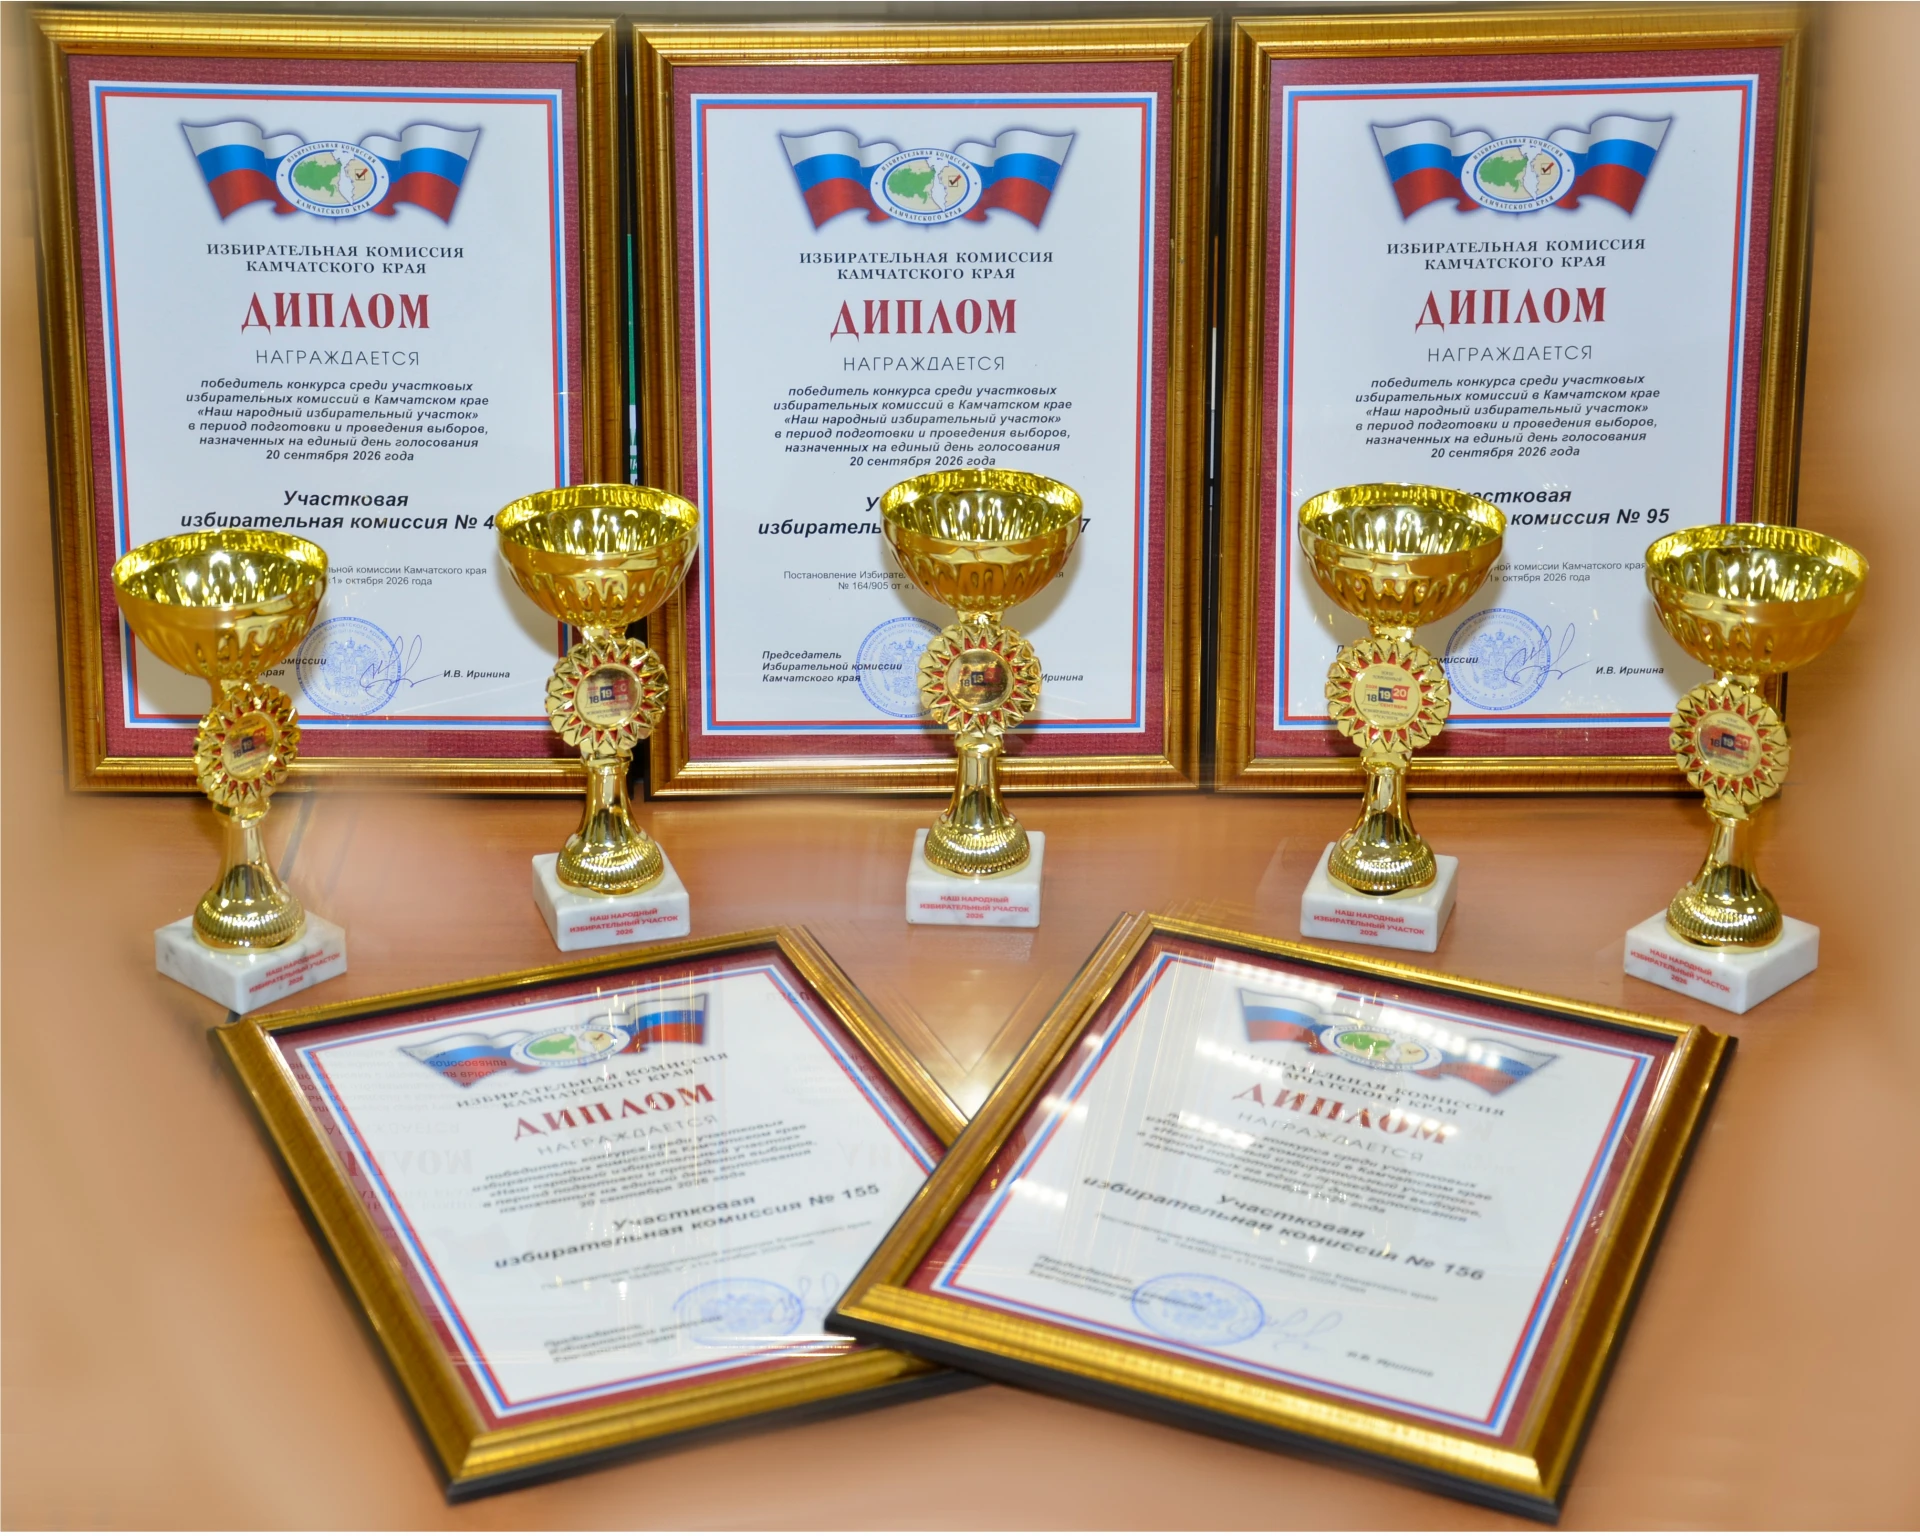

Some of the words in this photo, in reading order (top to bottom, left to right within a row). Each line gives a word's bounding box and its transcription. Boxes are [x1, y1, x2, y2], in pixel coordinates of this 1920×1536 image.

[341, 143, 377, 164] КОМИССИЯ
[295, 198, 350, 215] КАМЧАТСКОГО
[352, 200, 371, 213] КРАЯ
[206, 243, 358, 257] ИЗБИРАТЕЛЬНАЯ
[365, 245, 464, 259] КОМИССИЯ
[1386, 240, 1538, 255] ИЗБИРАТЕЛЬНАЯ
[1545, 238, 1646, 252] КОМИССИЯ
[799, 251, 948, 264] ИЗБИРАТЕЛЬНАЯ
[955, 251, 1054, 264] КОМИССИЯ
[1424, 256, 1554, 271] КАМЧАТСКОГО
[1561, 255, 1606, 268] КРАЯ
[246, 260, 375, 274] КАМЧАТСКОГО
[382, 262, 427, 275] КРАЯ
[837, 268, 965, 280] КАМЧАТСКОГО
[971, 267, 1016, 280] КРАЯ
[240, 291, 430, 335] ДИПЛОМ
[1414, 286, 1607, 333] ДИПЛОМ
[829, 298, 1017, 342] ДИПЛОМ
[255, 349, 420, 367] НАГРАЖДАЕТСЯ
[1427, 344, 1593, 363] НАГРАЖДАЕТСЯ
[843, 355, 1005, 372] НАГРАЖДАЕТСЯ
[200, 377, 284, 390] победитель
[286, 380, 347, 393] конкурса
[348, 379, 389, 393] среди
[390, 382, 474, 394] участковых
[787, 384, 870, 397] победитель
[872, 387, 932, 399] конкурса
[933, 384, 973, 399] среди
[975, 386, 1058, 399] участковых
[185, 391, 294, 405] избирательных
[295, 393, 360, 405] комиссий
[362, 395, 371, 405] в
[373, 393, 457, 406] Камчатском
[459, 396, 490, 409] крае
[197, 405, 234, 418] «Наш
[235, 405, 303, 420] народный
[305, 406, 414, 421] избирательный
[415, 410, 479, 422] участок»
[1365, 405, 1402, 417] «Наш
[1403, 404, 1471, 419] народный
[1473, 402, 1583, 418] избирательный
[1584, 403, 1649, 417] участок»
[187, 422, 196, 431] в
[199, 419, 248, 434] период
[249, 420, 332, 433] подготовки
[334, 423, 343, 433] и
[345, 421, 424, 436] проведения
[426, 422, 489, 437] выборов,
[783, 413, 820, 425] «Наш
[821, 412, 888, 427] народный
[890, 412, 997, 427] избирательный
[999, 414, 1062, 427] участок»
[198, 436, 286, 446] назначенных
[287, 437, 304, 447] на
[306, 434, 358, 447] единый
[360, 435, 392, 448] день
[394, 438, 480, 448] голосования
[265, 448, 281, 461] 20
[283, 449, 349, 463] сентября
[352, 449, 382, 462] 2026
[383, 449, 415, 462] года
[1430, 447, 1446, 459] 20
[1447, 446, 1515, 460] сентября
[1517, 445, 1548, 458] 2026
[1549, 445, 1581, 457] года
[849, 455, 865, 467] 20
[866, 455, 932, 469] сентября
[934, 455, 964, 467] 2026
[965, 454, 997, 470] года
[283, 489, 409, 508] Участковая
[180, 510, 345, 530] избирательная
[349, 516, 449, 530] комиссия
[453, 513, 479, 530] №
[1509, 512, 1611, 526] комиссия
[1615, 508, 1641, 525] №
[1646, 507, 1671, 525] 95
[757, 515, 883, 539] избиратель
[355, 566, 402, 575] комиссии
[403, 565, 464, 576] Камчатского
[464, 567, 488, 577] края
[1513, 563, 1560, 572] комиссии
[1561, 561, 1623, 571] Камчатского
[344, 575, 384, 587] октября
[385, 575, 410, 586] 2026
[410, 577, 433, 587] года
[783, 570, 858, 580] Постановление
[858, 570, 902, 583] Избирате
[1502, 573, 1541, 584] октября
[1543, 573, 1568, 584] 2026
[1569, 574, 1592, 584] года
[280, 656, 327, 667] омиссии
[761, 649, 843, 662] Председатель
[442, 669, 464, 679] И.В.
[465, 669, 511, 681] Иринина
[761, 661, 849, 673] Избирательной
[850, 659, 903, 674] комиссии
[1595, 665, 1617, 675] И.В.
[1618, 665, 1665, 677] Иринина
[761, 673, 835, 683] Камчатского
[836, 673, 862, 684] края
[1367, 694, 1377, 703] 18
[940, 894, 960, 902] НАШ
[961, 894, 1009, 904] НАРОДНЫЙ
[590, 914, 610, 923] НАШ
[611, 907, 658, 920] НАРОДНЫЙ
[919, 903, 991, 912] ИЗБИРАТЕЛЬНЫЙ
[992, 905, 1030, 914] УЧАСТОК
[1335, 909, 1354, 917] НАШ
[1356, 911, 1404, 924] НАРОДНЫЙ
[569, 918, 640, 934] ИЗБИРАТЕЛЬНЫЙ
[641, 915, 678, 926] УЧАСТОК
[616, 928, 633, 936] 2026
[1313, 915, 1386, 930] ИЗБИРАТЕЛЬНЫЙ
[1387, 925, 1425, 936] УЧАСТОК
[1360, 929, 1378, 937] 2026
[1649, 948, 1667, 960] НАШ
[1668, 954, 1713, 977] НАРОДНЫЙ
[1630, 950, 1695, 979] ИЗБИРАТЕЛЬНЫЙ
[1695, 975, 1731, 993] УЧАСТОК
[457, 1072, 617, 1109] ИЗБИРАТЕЛЬНАЯ
[626, 1052, 729, 1081] КОМИССИЯ
[503, 1078, 641, 1109] КАМЧАТСКОГО
[647, 1068, 695, 1084] КРАЯ
[1395, 1086, 1506, 1117] КОМИССИЯ
[1408, 1099, 1459, 1117] КРАЯ
[514, 1082, 715, 1142] ДИПЛОМ
[1232, 1082, 1449, 1146] ДИПЛОМ
[537, 1113, 719, 1156] НАГРАЖДАЕТСЯ
[1237, 1111, 1424, 1162] НАГРАЖДАЕТСЯ
[612, 1194, 756, 1232] Участковая
[1218, 1193, 1366, 1241] Участковая
[494, 1223, 685, 1270] избирательная
[690, 1199, 803, 1232] комиссия
[808, 1190, 836, 1207] №
[840, 1183, 881, 1201] 155
[1082, 1175, 1274, 1232] избирательная
[1278, 1226, 1398, 1262] комиссия
[1404, 1253, 1435, 1271] №
[1442, 1261, 1486, 1282] 156
